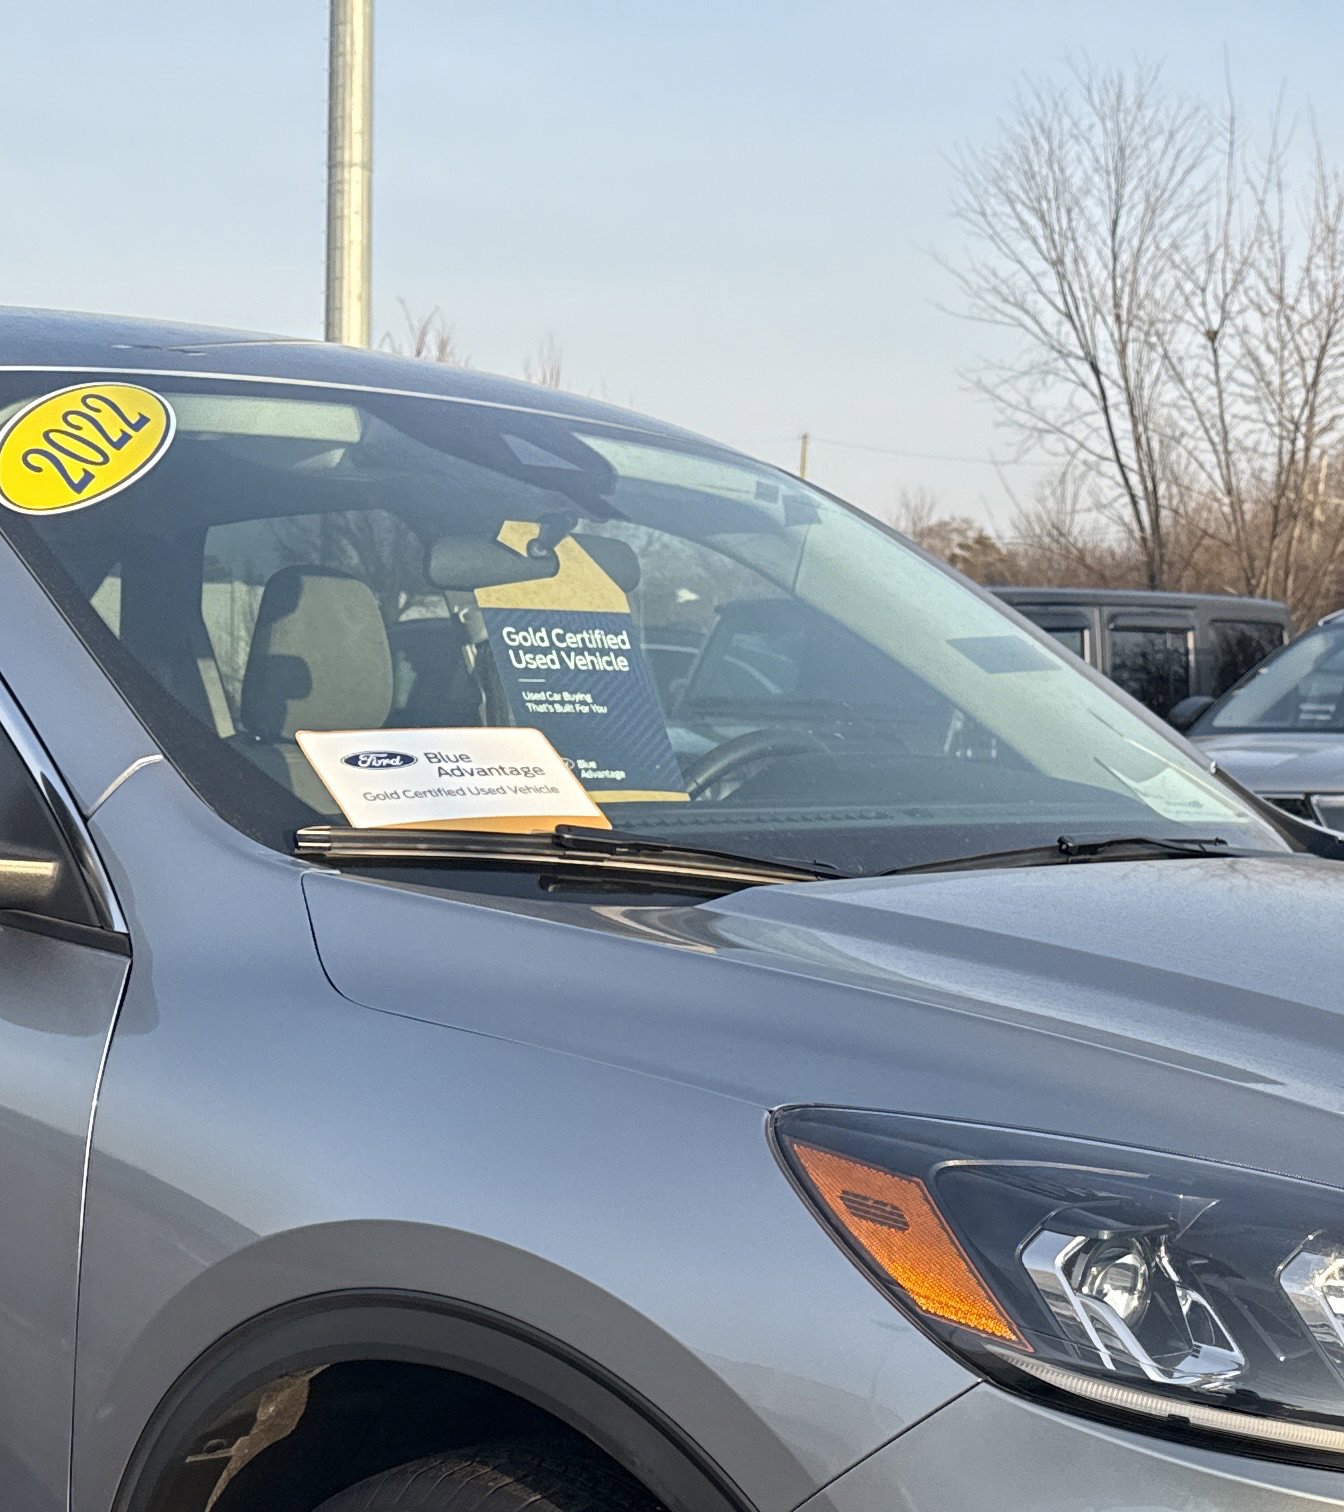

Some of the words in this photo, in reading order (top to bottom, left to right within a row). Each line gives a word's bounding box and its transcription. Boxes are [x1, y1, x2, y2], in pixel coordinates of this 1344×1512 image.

[22, 393, 151, 495] 2022
[502, 626, 551, 648] Gold
[551, 628, 632, 650] Certified
[509, 649, 561, 670] Used
[561, 651, 630, 672] Vehicle
[522, 690, 546, 701] Used
[546, 691, 562, 701] Car
[562, 691, 593, 704] Buying
[525, 702, 554, 713] That's
[554, 703, 575, 713] Built
[575, 703, 590, 714] For
[590, 704, 608, 714] You
[358, 753, 404, 768] Ford
[423, 751, 472, 764] Blue
[437, 764, 546, 778] Advantage
[363, 790, 401, 802] Gold
[402, 786, 467, 799] Certified
[467, 785, 507, 796] Used
[507, 785, 560, 796] Vehicle
